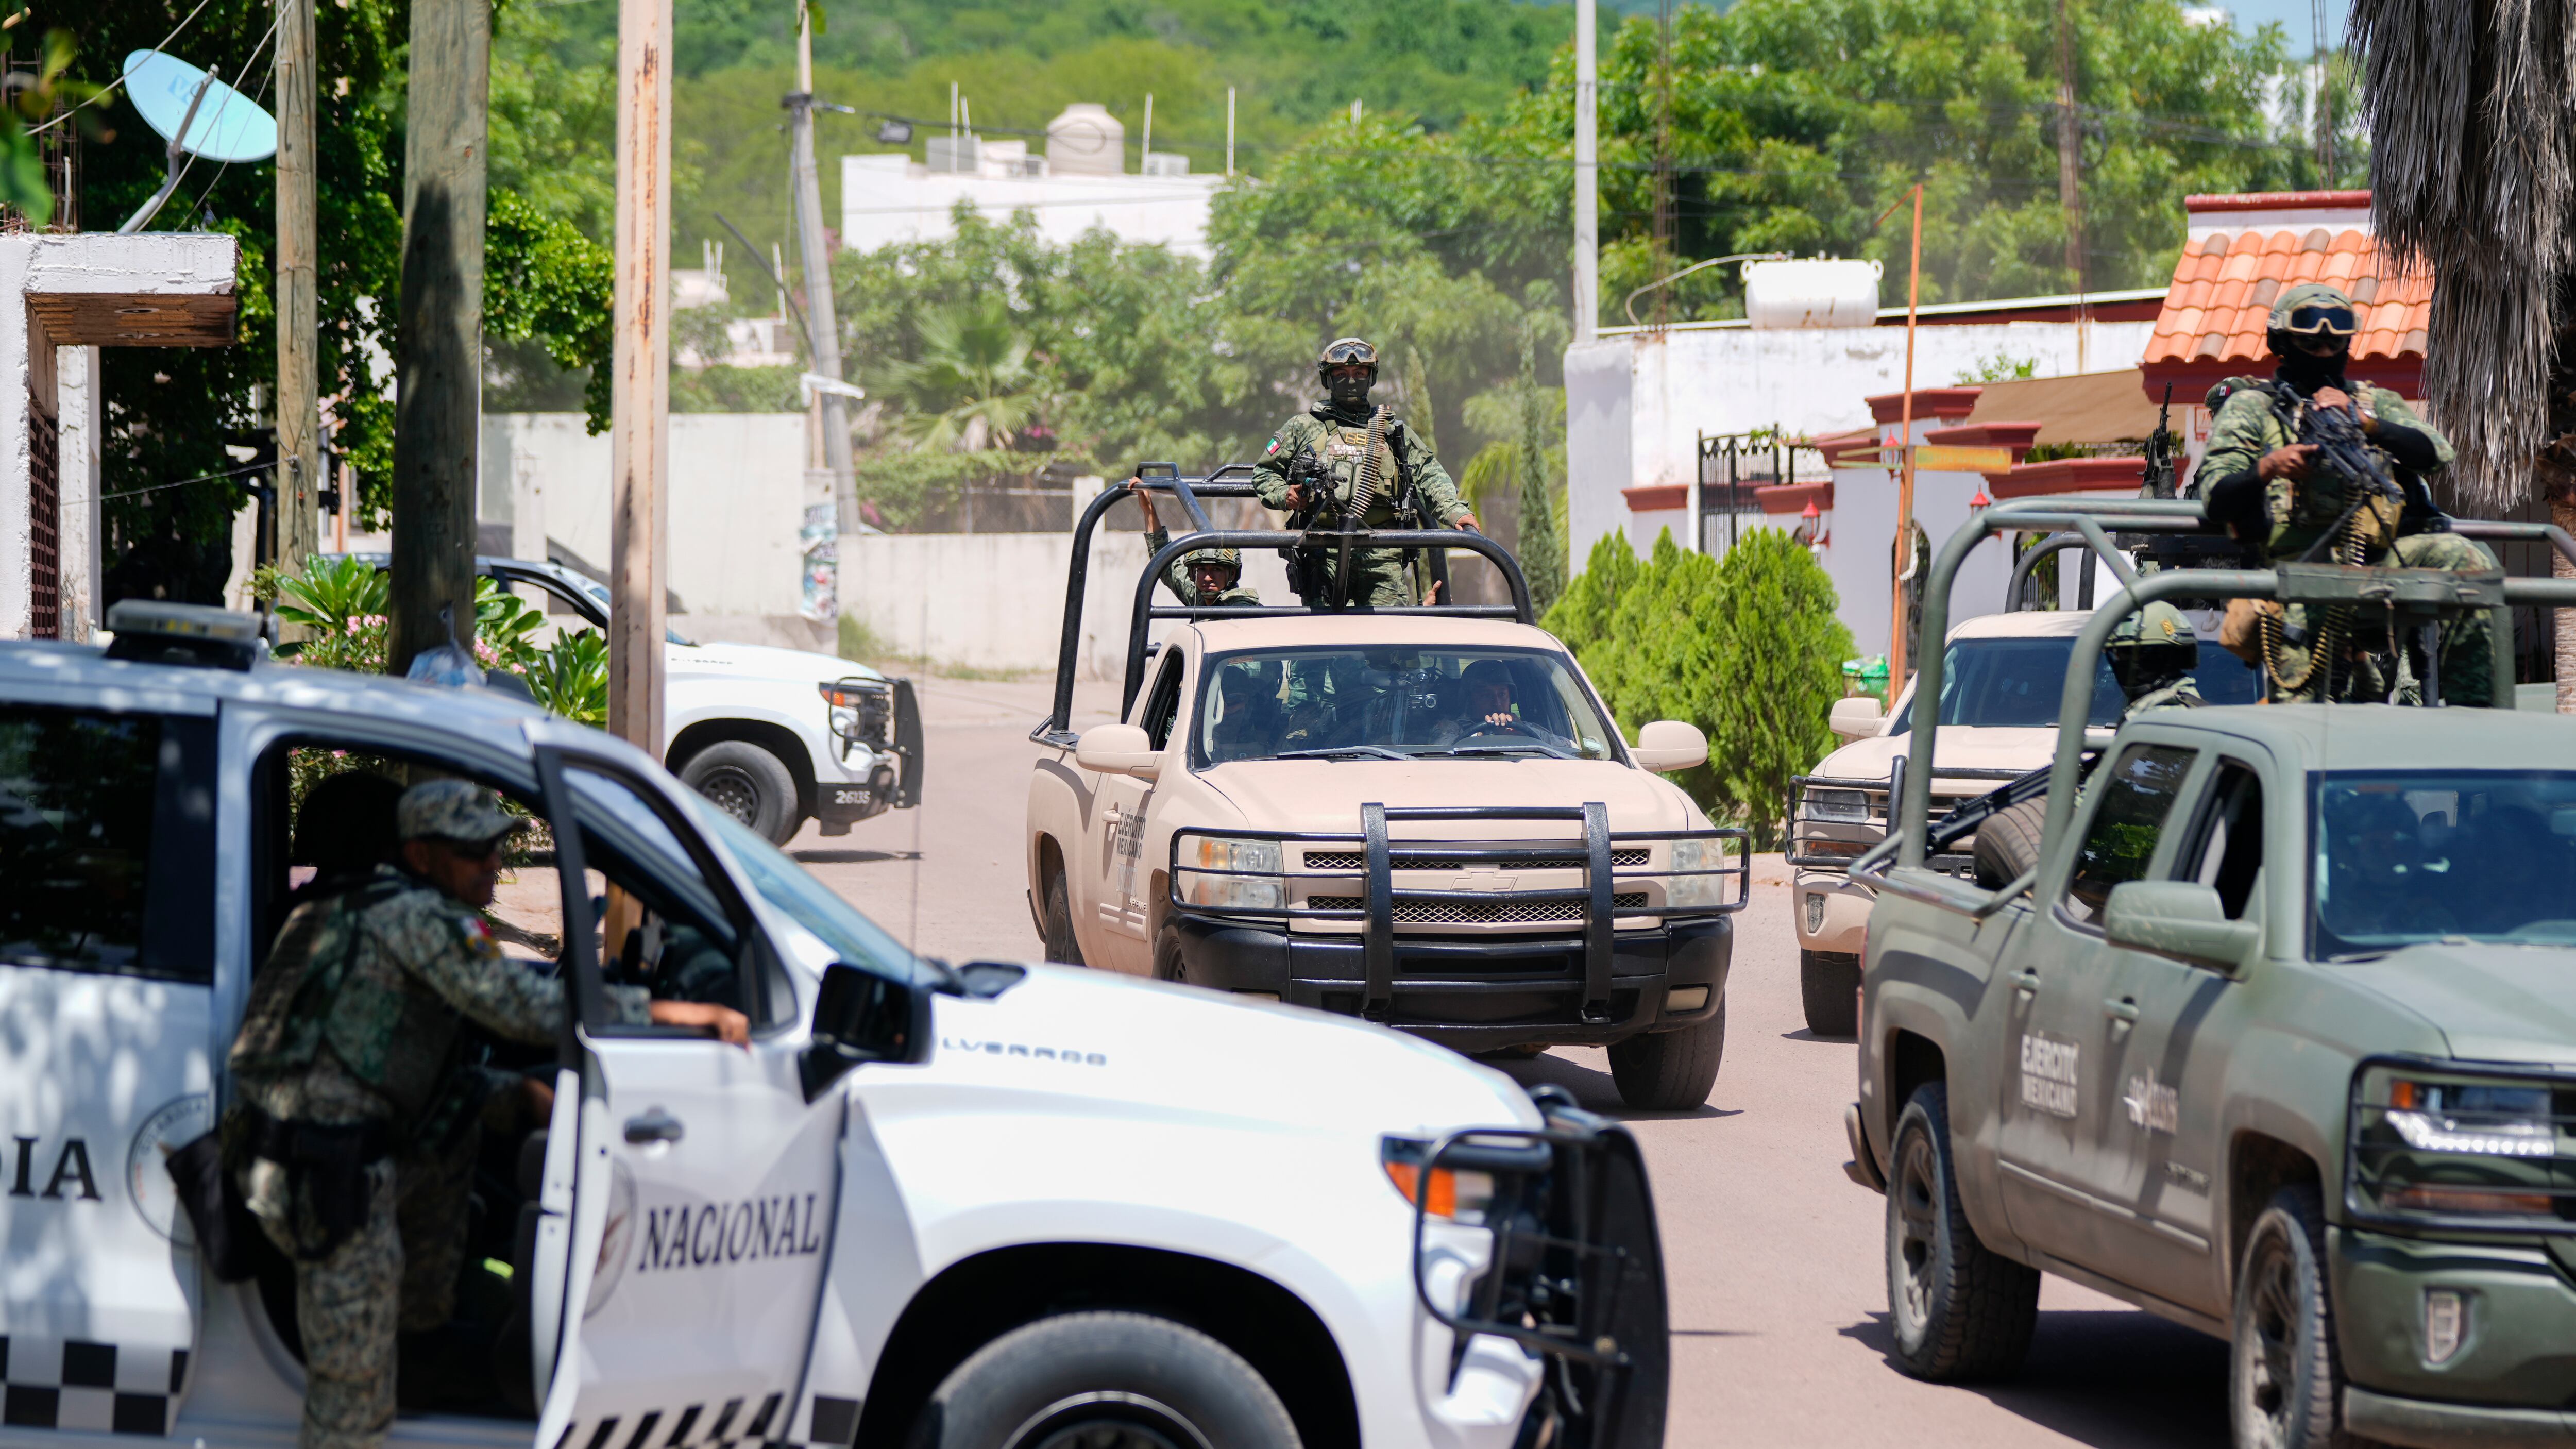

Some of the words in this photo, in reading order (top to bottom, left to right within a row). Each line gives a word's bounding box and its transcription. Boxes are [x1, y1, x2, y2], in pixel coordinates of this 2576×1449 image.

[1118, 808, 1146, 840] EJÉRCITO
[1116, 837, 1142, 860] MEXICANO
[2022, 1073, 2078, 1117] MEXICANO
[0, 1135, 104, 1203] IA
[638, 1188, 820, 1272] NACIONAL
